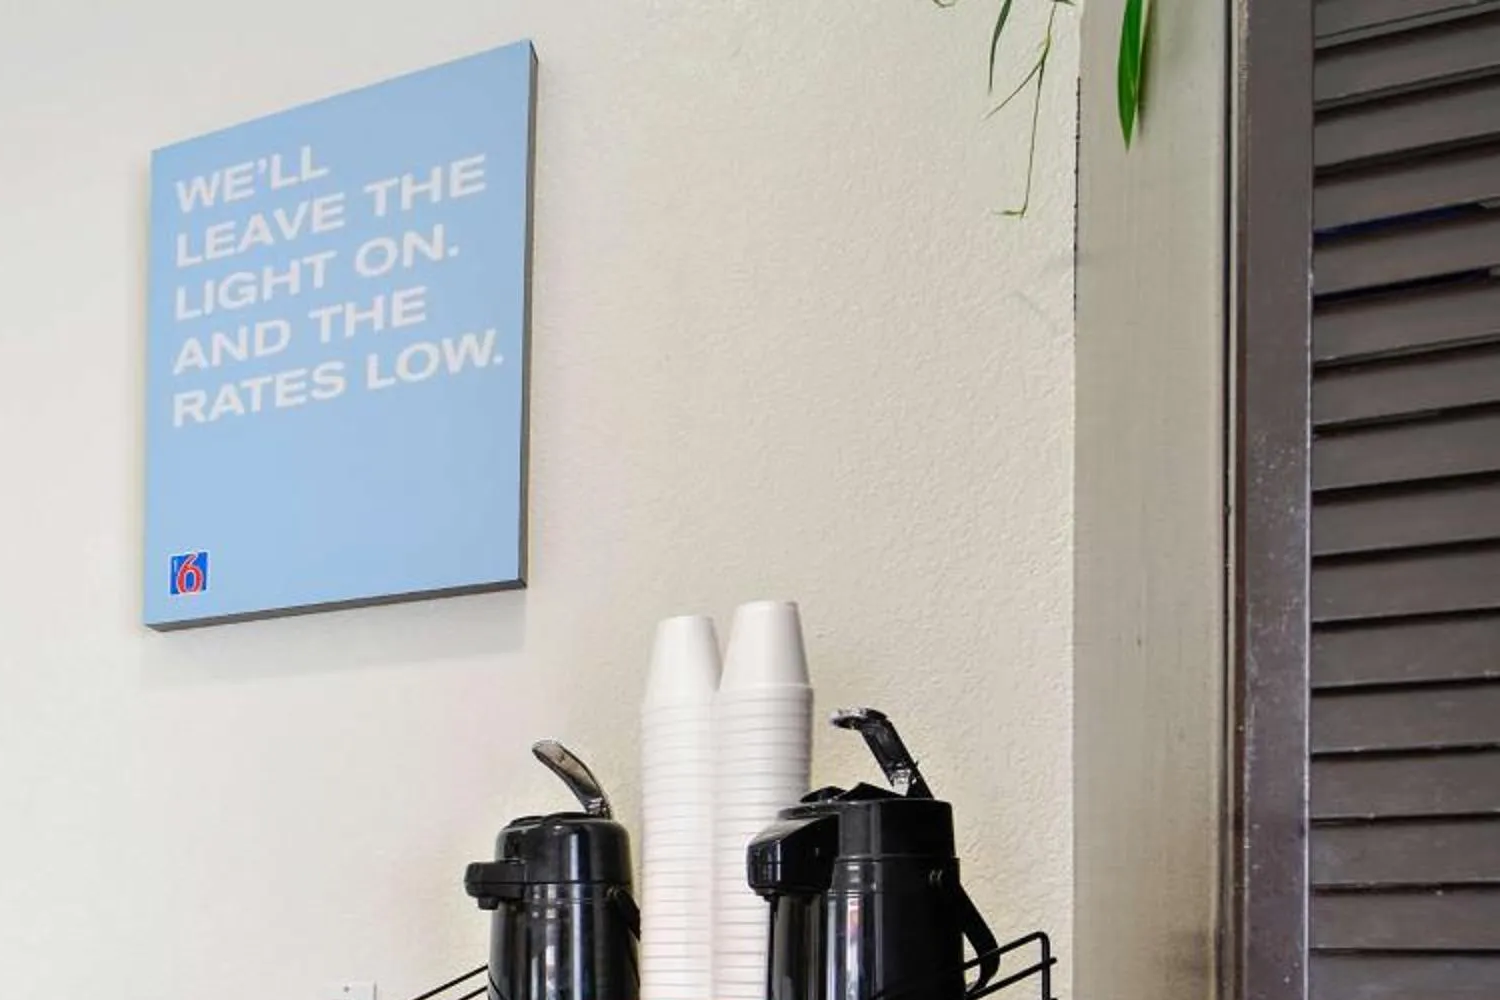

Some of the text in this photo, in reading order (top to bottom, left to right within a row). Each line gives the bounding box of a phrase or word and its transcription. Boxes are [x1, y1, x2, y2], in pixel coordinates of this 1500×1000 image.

[175, 145, 328, 213] WE'LL
[176, 153, 487, 268] LEAVE THE
[175, 223, 460, 321] LIGHT ON.
[172, 285, 427, 375] AND THE
[172, 328, 504, 427] RATES LOW.
